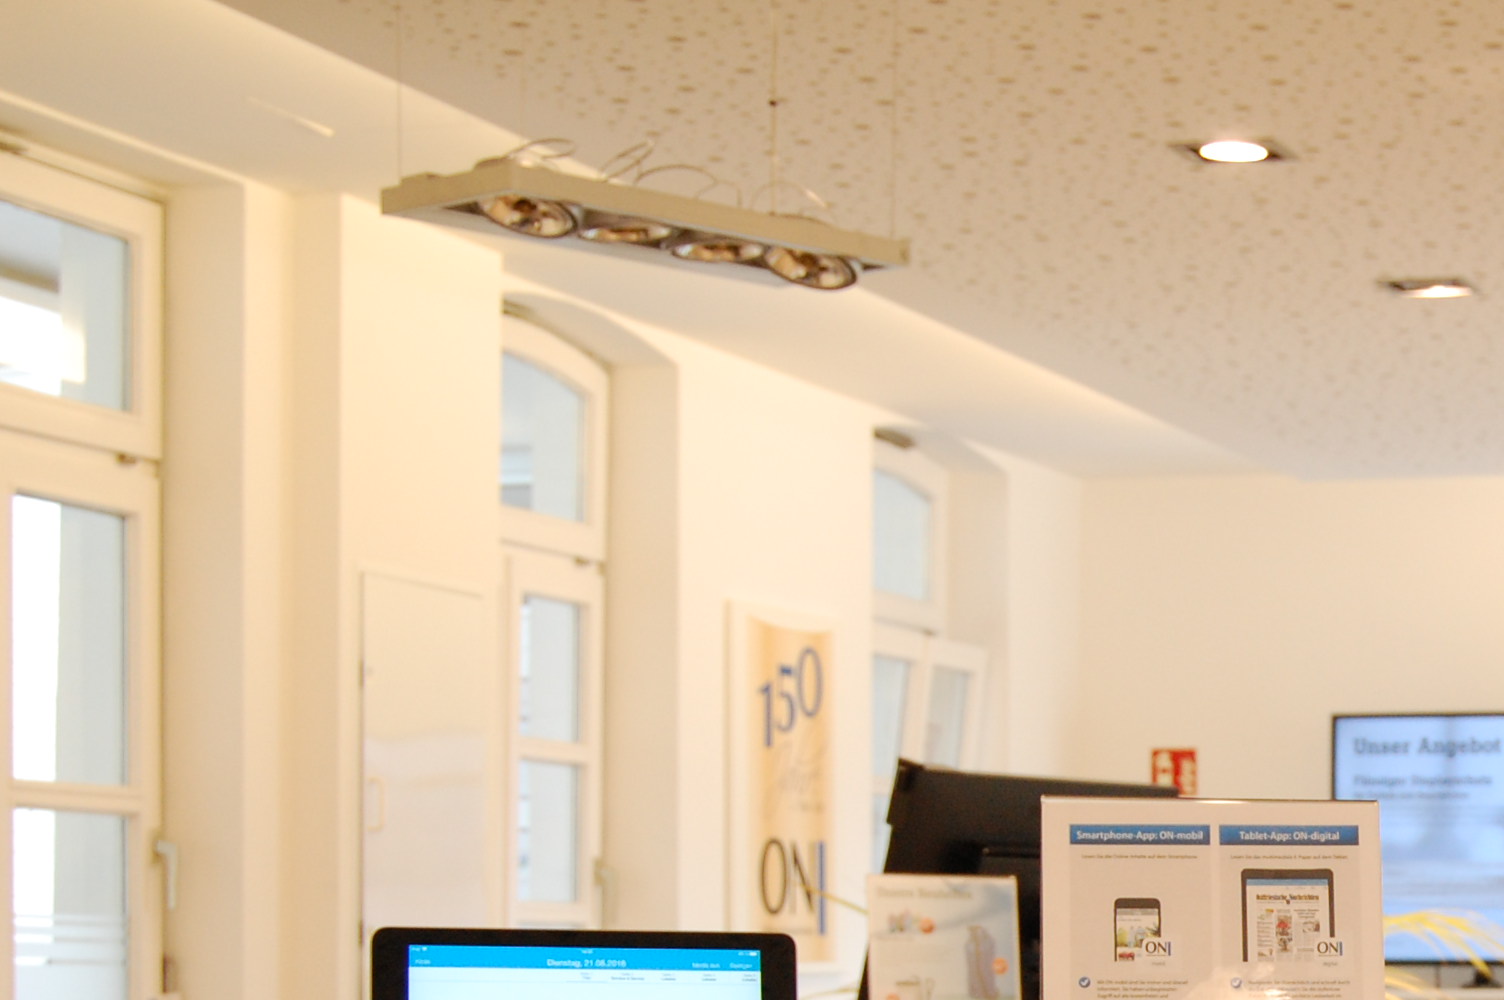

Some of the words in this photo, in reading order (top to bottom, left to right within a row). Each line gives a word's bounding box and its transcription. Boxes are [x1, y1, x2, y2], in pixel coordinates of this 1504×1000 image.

[757, 647, 823, 747] 150
[1354, 737, 1410, 754] Unser
[1418, 737, 1502, 757] Angebot
[1076, 830, 1158, 841] Smartphone-App:
[1159, 830, 1203, 840] ON-mobil
[1240, 831, 1292, 842] Tablet-App:
[1293, 831, 1340, 842] ON-digital
